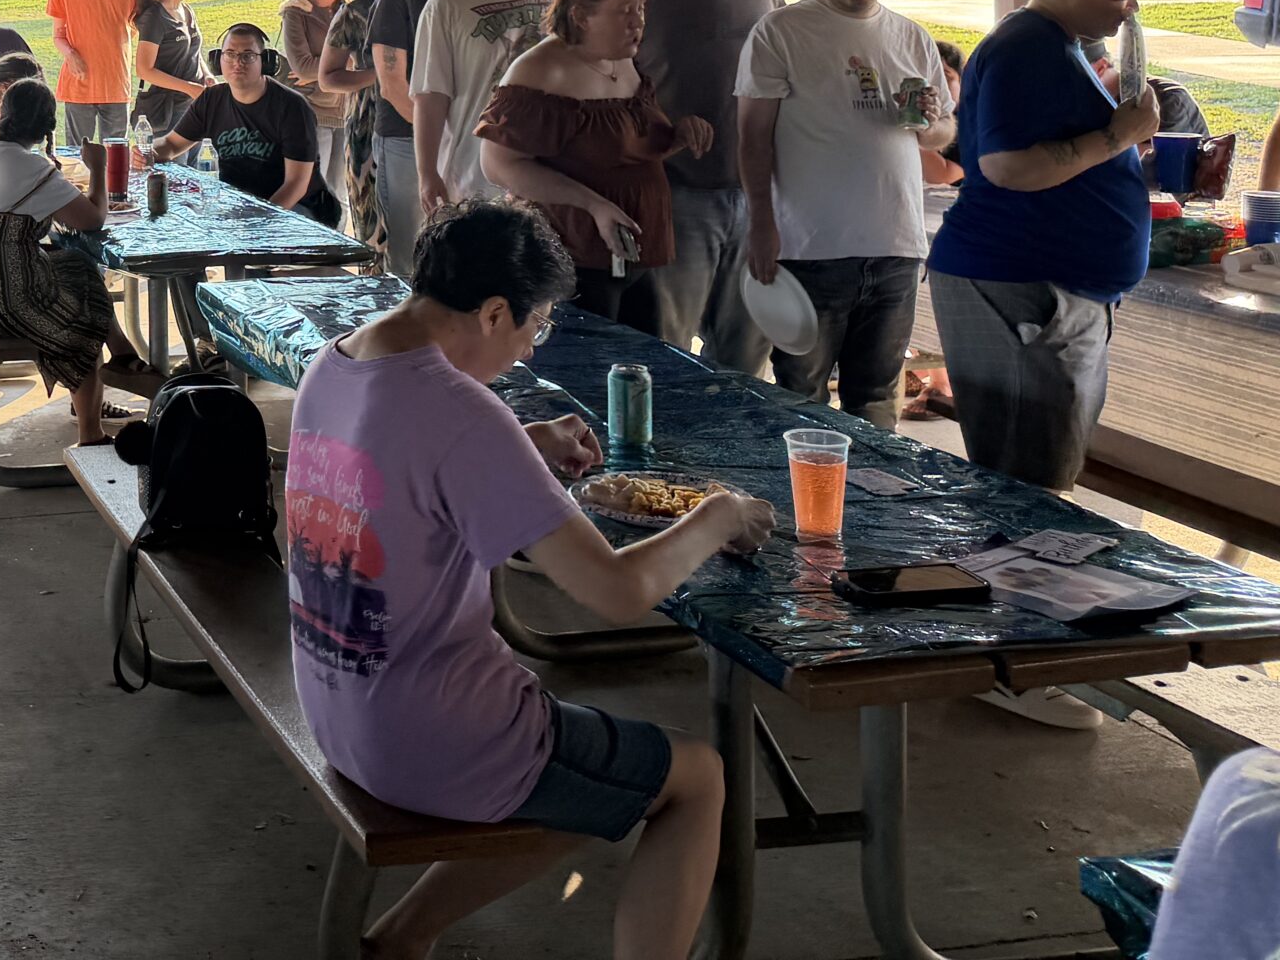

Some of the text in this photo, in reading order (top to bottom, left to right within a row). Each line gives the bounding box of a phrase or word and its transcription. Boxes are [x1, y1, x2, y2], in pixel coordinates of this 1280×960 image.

[471, 5, 542, 44] TURTL
[218, 127, 260, 145] GOD IS
[219, 141, 275, 157] FOR YOU!
[336, 503, 368, 552] God
